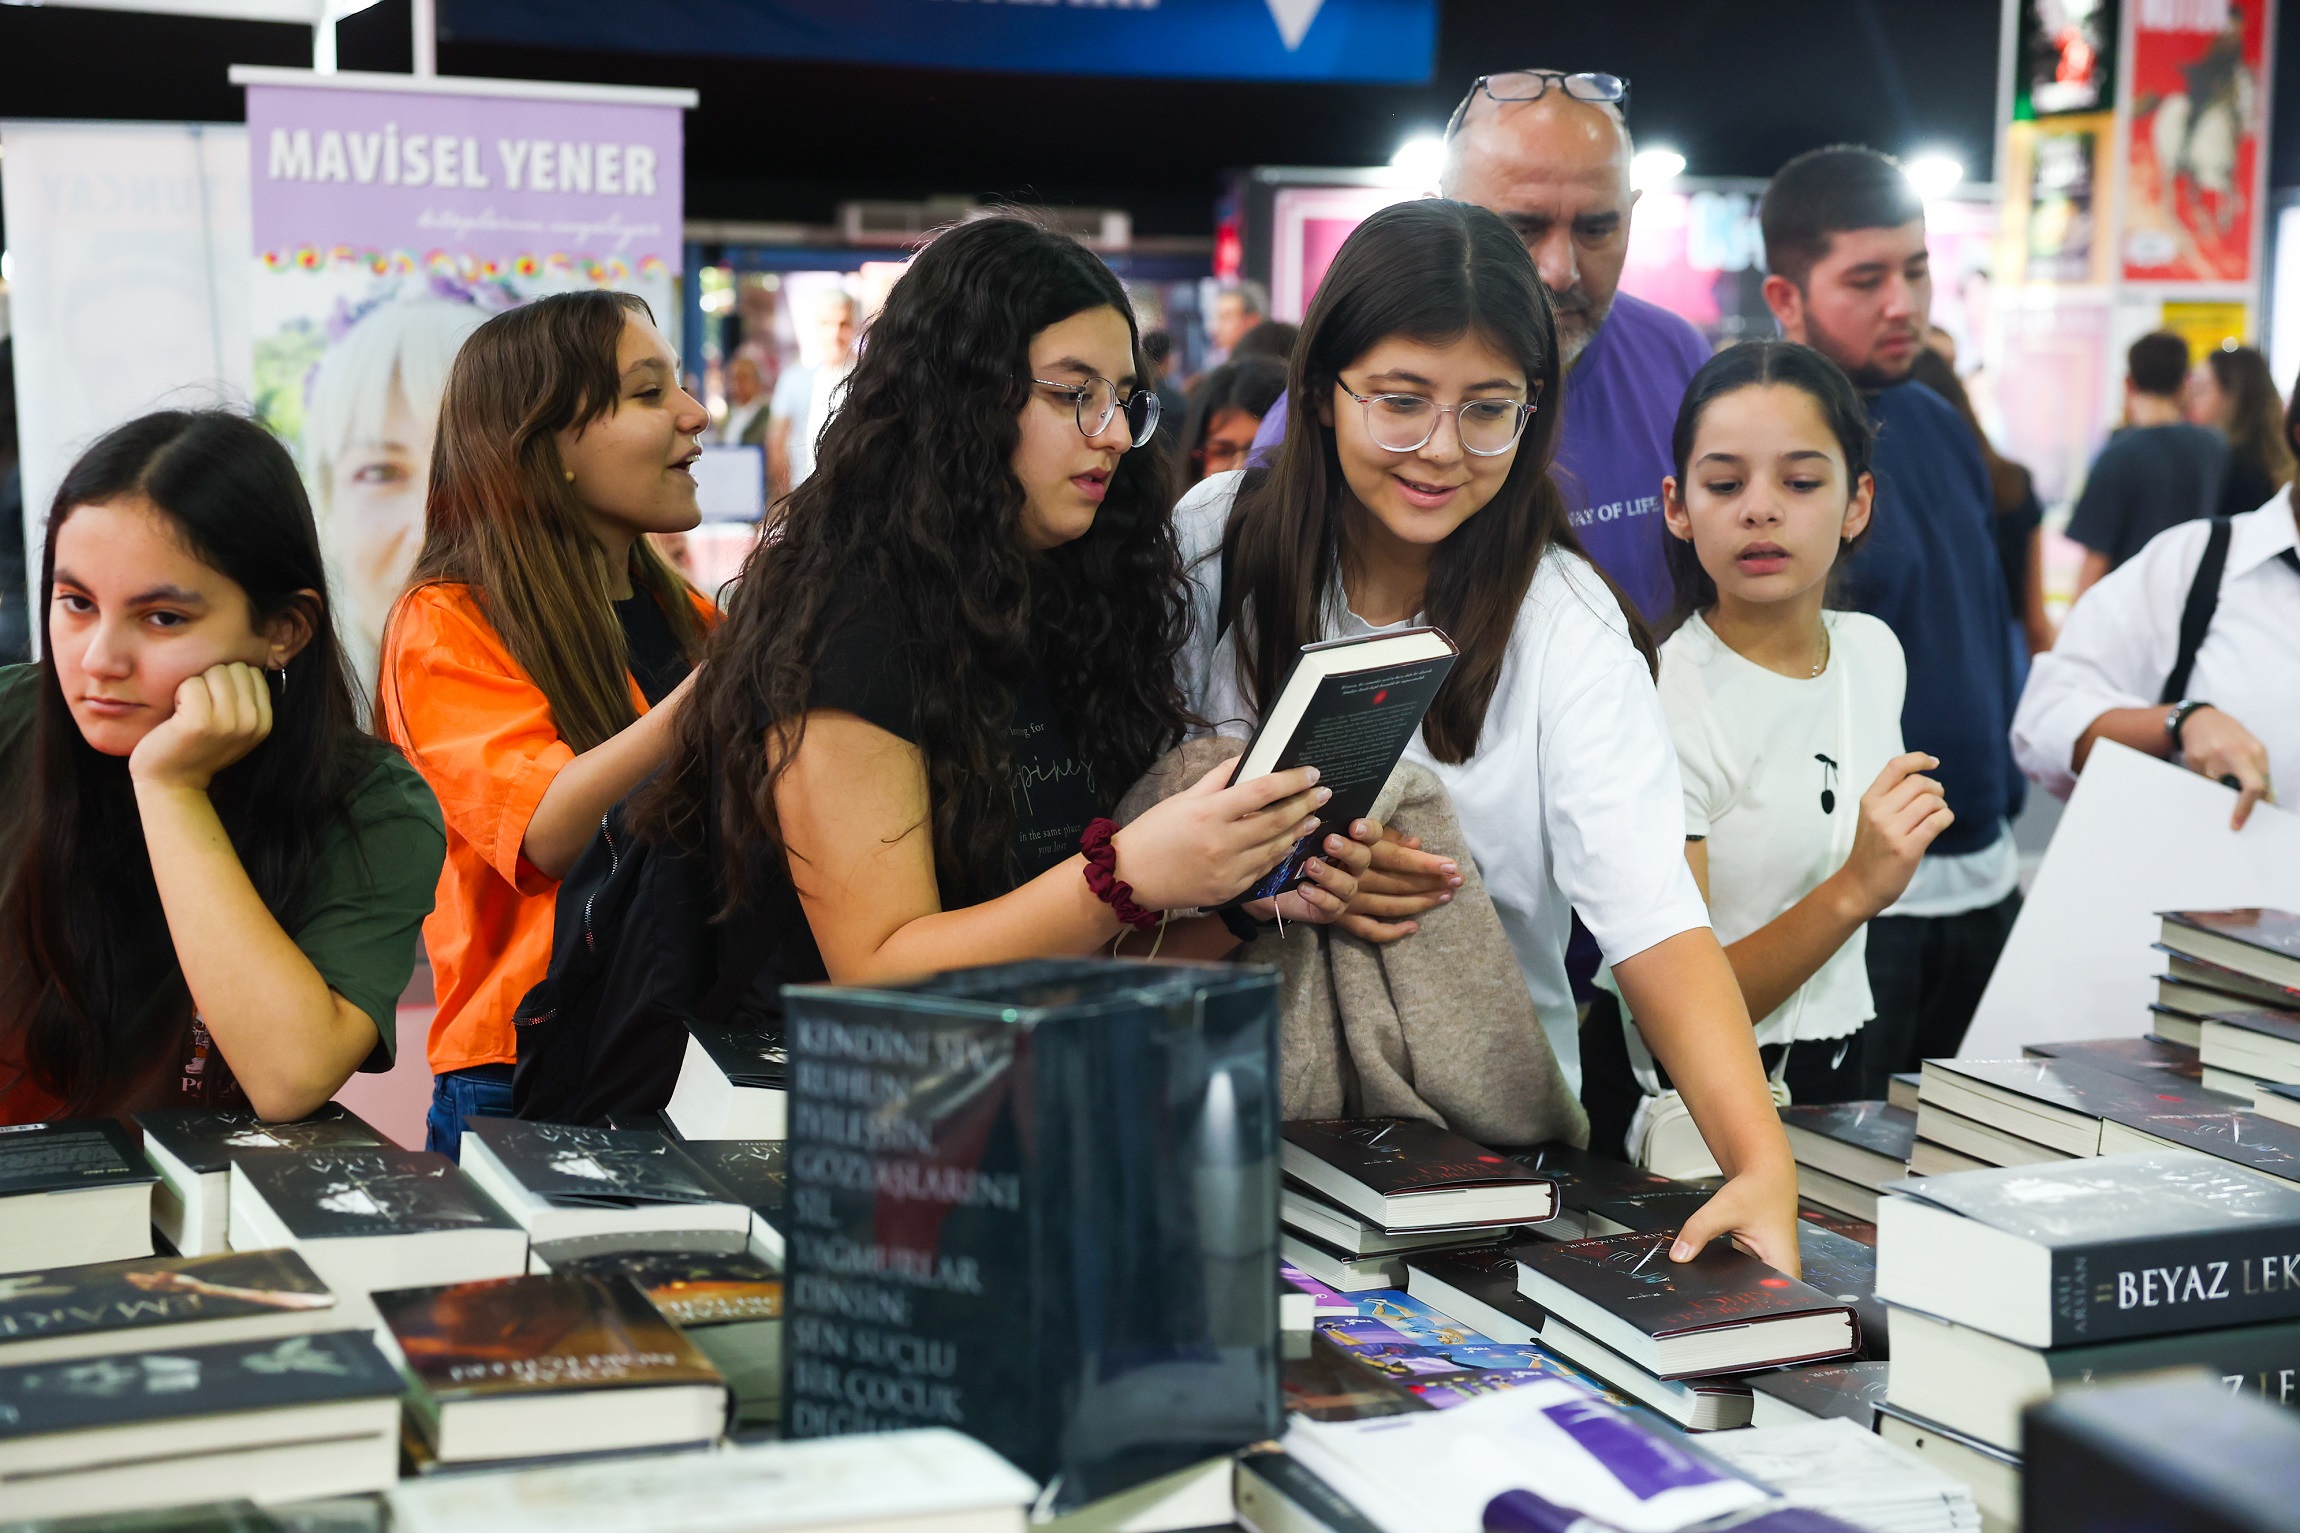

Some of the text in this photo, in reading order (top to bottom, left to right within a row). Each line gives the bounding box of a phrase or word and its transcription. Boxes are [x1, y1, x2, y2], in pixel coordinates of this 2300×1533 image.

[268, 122, 658, 197] MAVİSEL YENER
[1597, 501, 1623, 522] OF
[1625, 496, 1660, 517] LIFE
[1030, 722, 1045, 733] for
[1020, 831, 1028, 842] in
[1029, 829, 1042, 841] the
[1043, 827, 1062, 838] same
[2117, 1261, 2231, 1310] BEYAZ
